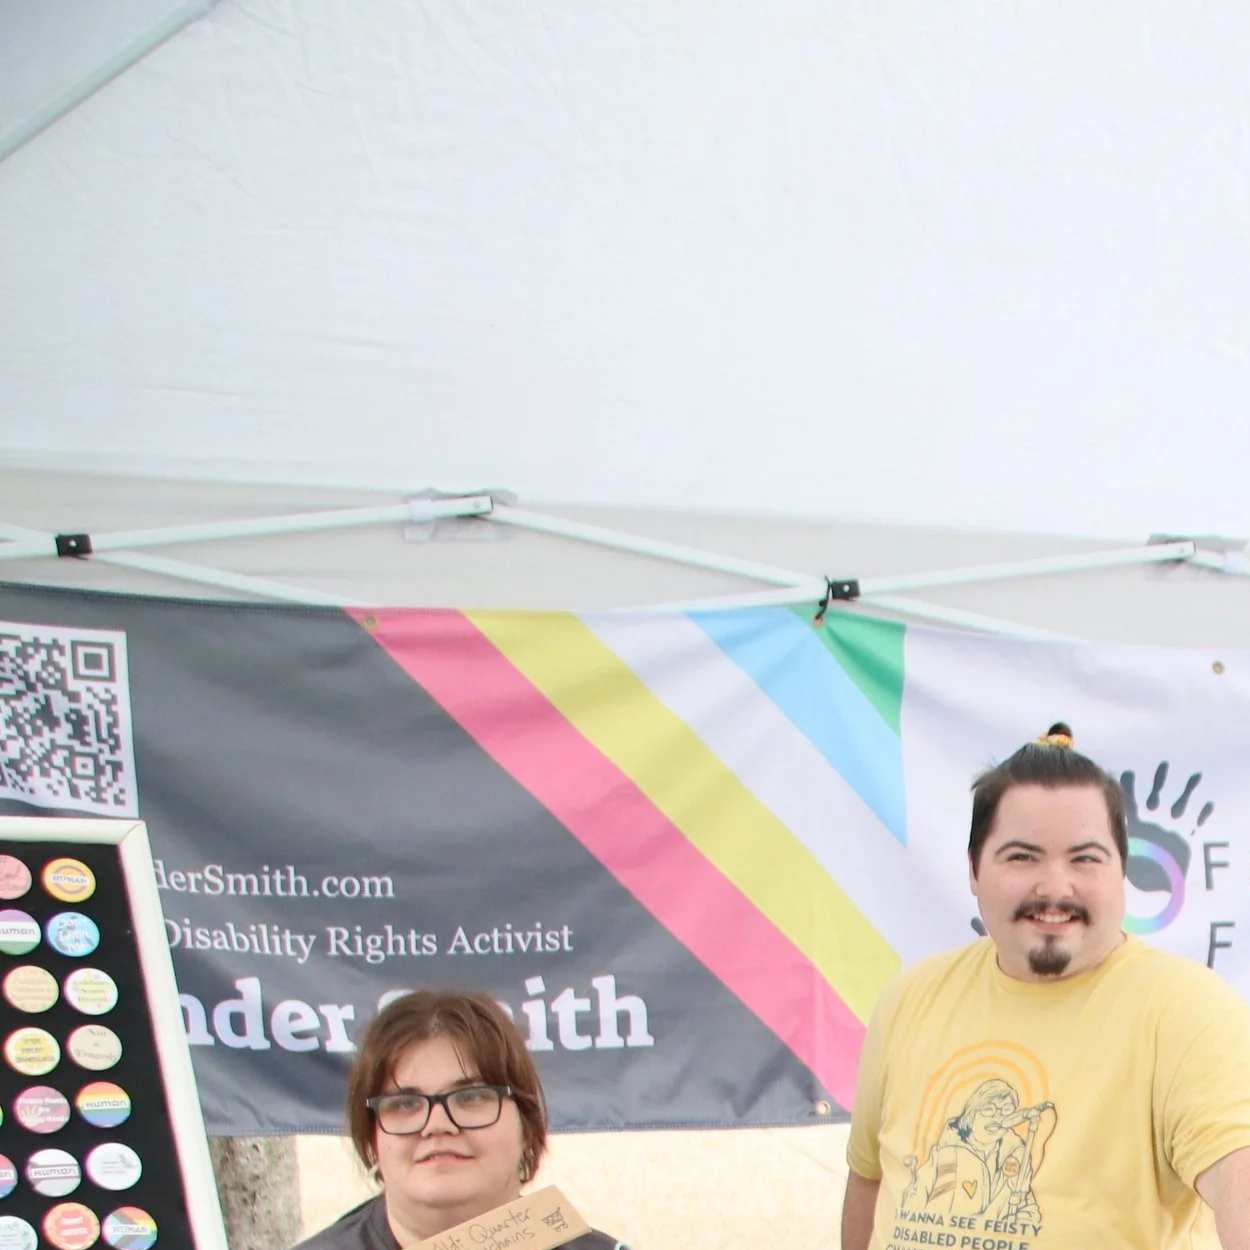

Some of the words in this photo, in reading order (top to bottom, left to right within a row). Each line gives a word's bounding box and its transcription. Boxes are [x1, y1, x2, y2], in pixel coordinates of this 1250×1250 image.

[0, 927, 36, 936] uman
[327, 926, 438, 963] Rights
[447, 924, 574, 955] Activist
[469, 1208, 530, 1243] Quarter
[893, 1226, 956, 1246] DISABLED
[900, 1210, 944, 1226] WANNA
[949, 1216, 977, 1230] SEE
[984, 1219, 1042, 1237] FEISTY
